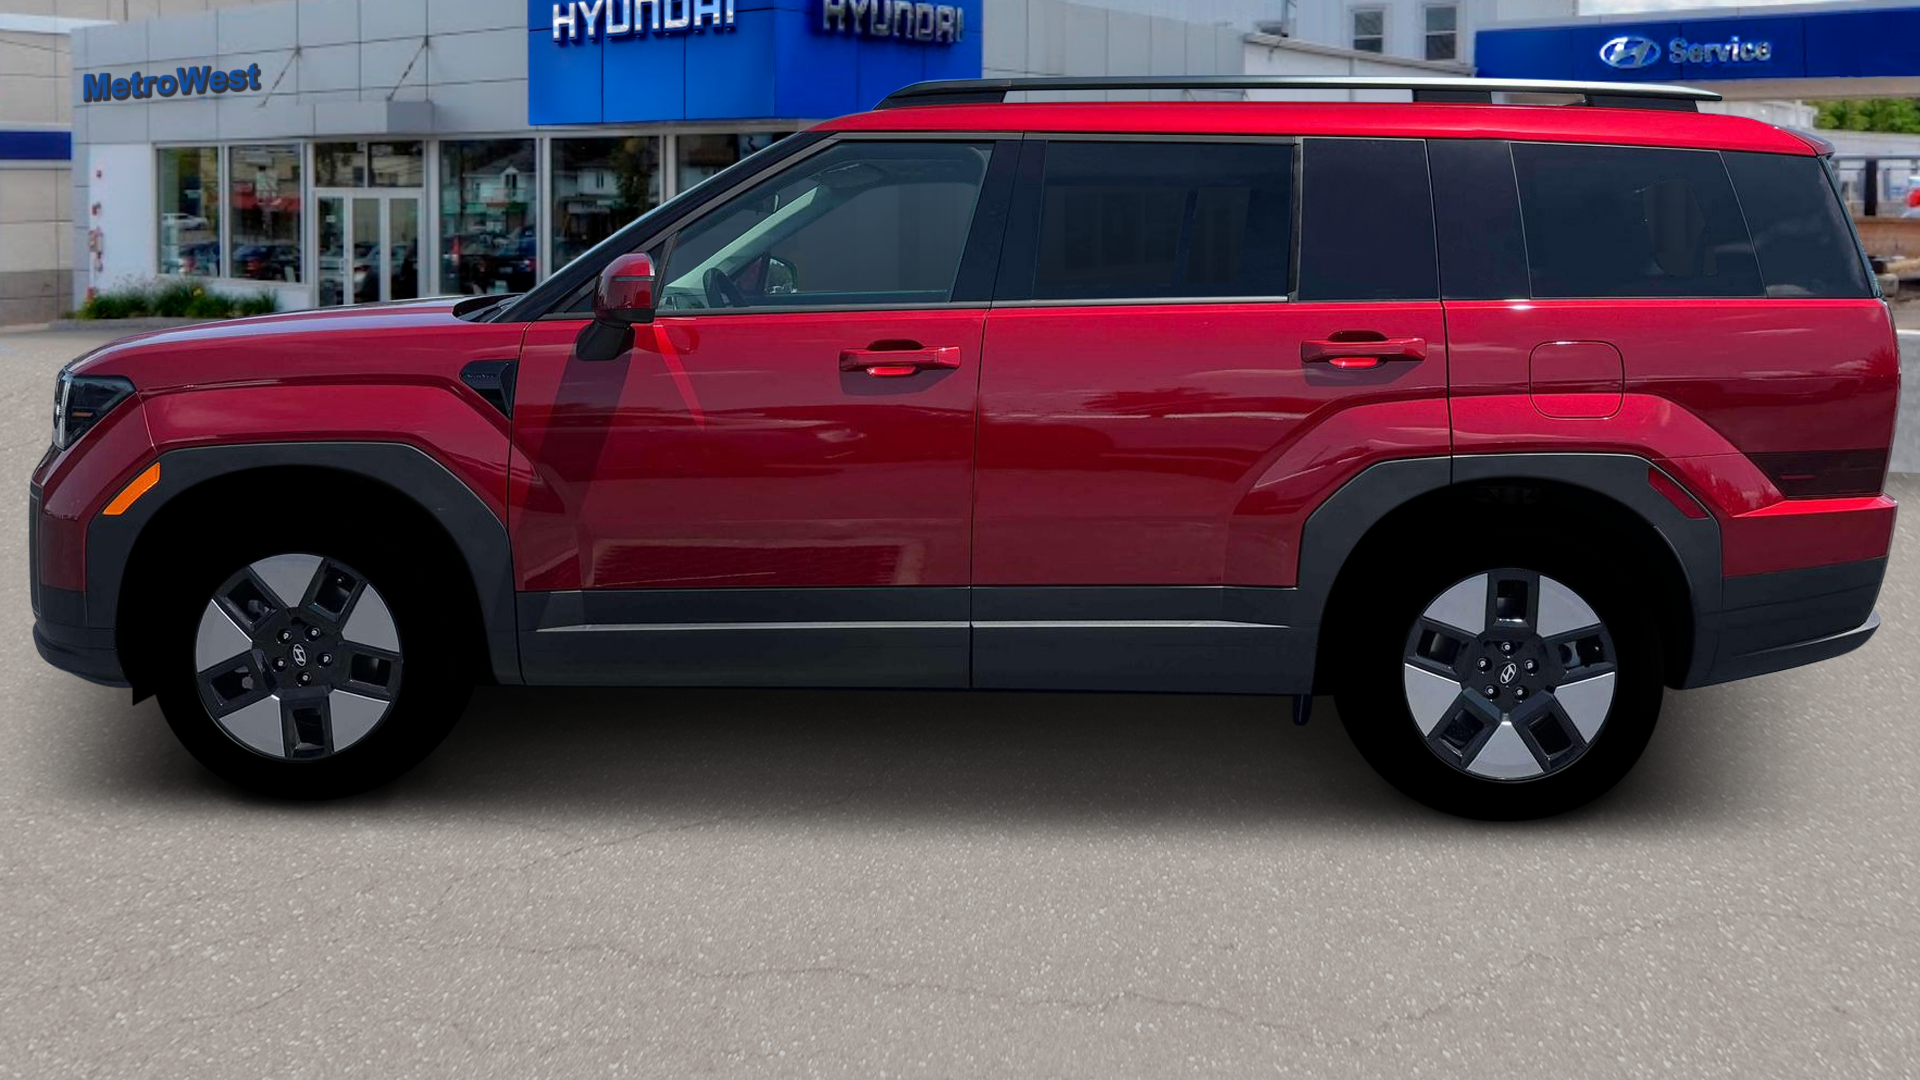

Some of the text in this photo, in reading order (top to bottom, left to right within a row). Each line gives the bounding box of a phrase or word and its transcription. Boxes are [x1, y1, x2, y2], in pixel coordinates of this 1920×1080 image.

[552, 0, 735, 40] HYUNDAI
[823, 0, 965, 43] HYUNDAI
[1669, 36, 1771, 64] Service
[83, 63, 262, 102] MetroWest
